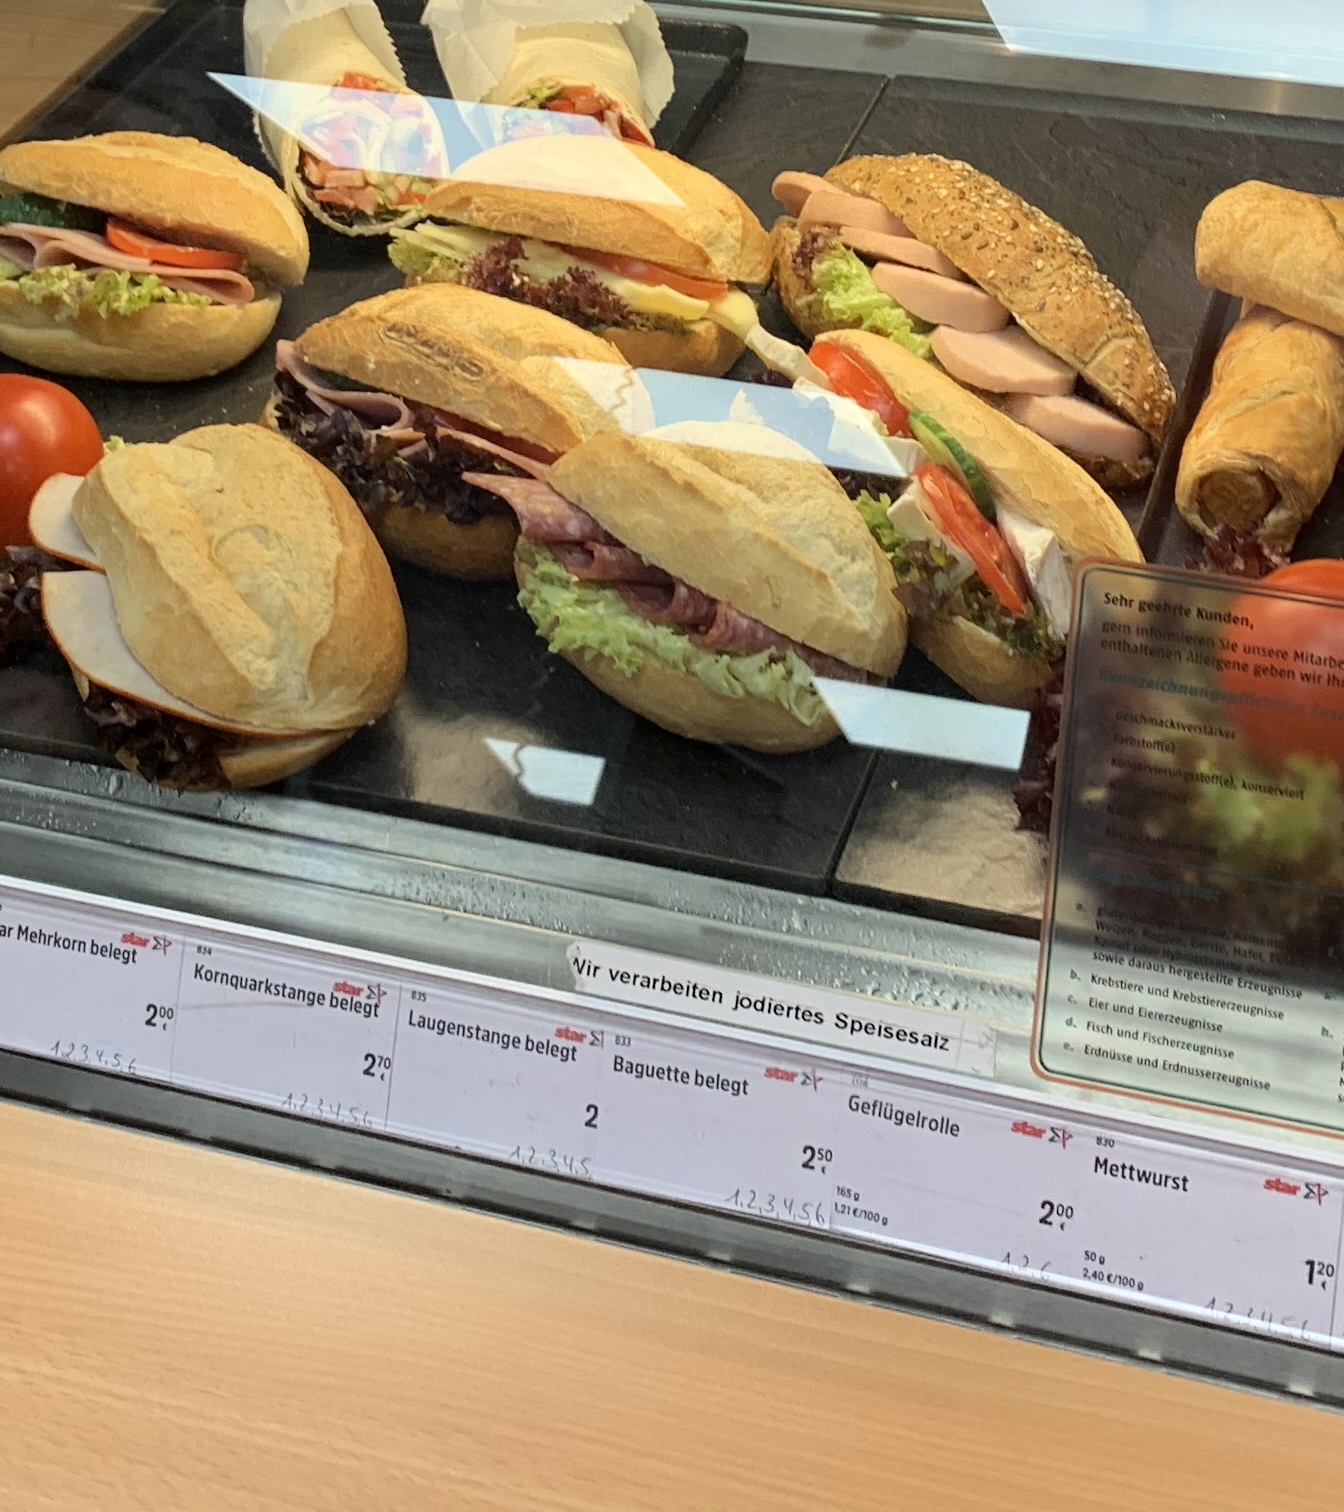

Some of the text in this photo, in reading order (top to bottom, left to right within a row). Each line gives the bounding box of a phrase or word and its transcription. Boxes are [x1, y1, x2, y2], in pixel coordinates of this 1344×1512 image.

[1103, 592, 1255, 631] Sehr geehrte Kunden,
[1185, 649, 1250, 674] Allergene
[1252, 661, 1297, 682] geben
[1299, 670, 1324, 686] wir
[1242, 642, 1289, 662] unsere
[16, 923, 88, 953] Mehrkorn
[90, 938, 138, 965] belegt
[193, 963, 380, 1019] Kornquarkstange belegt
[608, 966, 724, 1006] verarbeiten
[731, 989, 825, 1026] jodiertes
[1090, 973, 1144, 994] Krebstiere
[1146, 985, 1170, 998] und
[1092, 951, 1304, 1001] sowie daraus hergestellte Erzeugnisse
[1086, 1020, 1114, 1036] Fisch
[1116, 1027, 1139, 1041] und
[1088, 996, 1224, 1033] Eier und Eiererzeugnisse
[407, 1008, 577, 1063] Laugenstange belegt
[612, 1054, 691, 1088] Baguette
[693, 1070, 750, 1097] belegt
[1084, 1044, 1271, 1091] Erdnüsse und Erdnusserzeugnisse
[584, 1103, 600, 1130] 2
[848, 1094, 961, 1139] Geflügelrolle
[1093, 1155, 1190, 1192] Mettwurst
